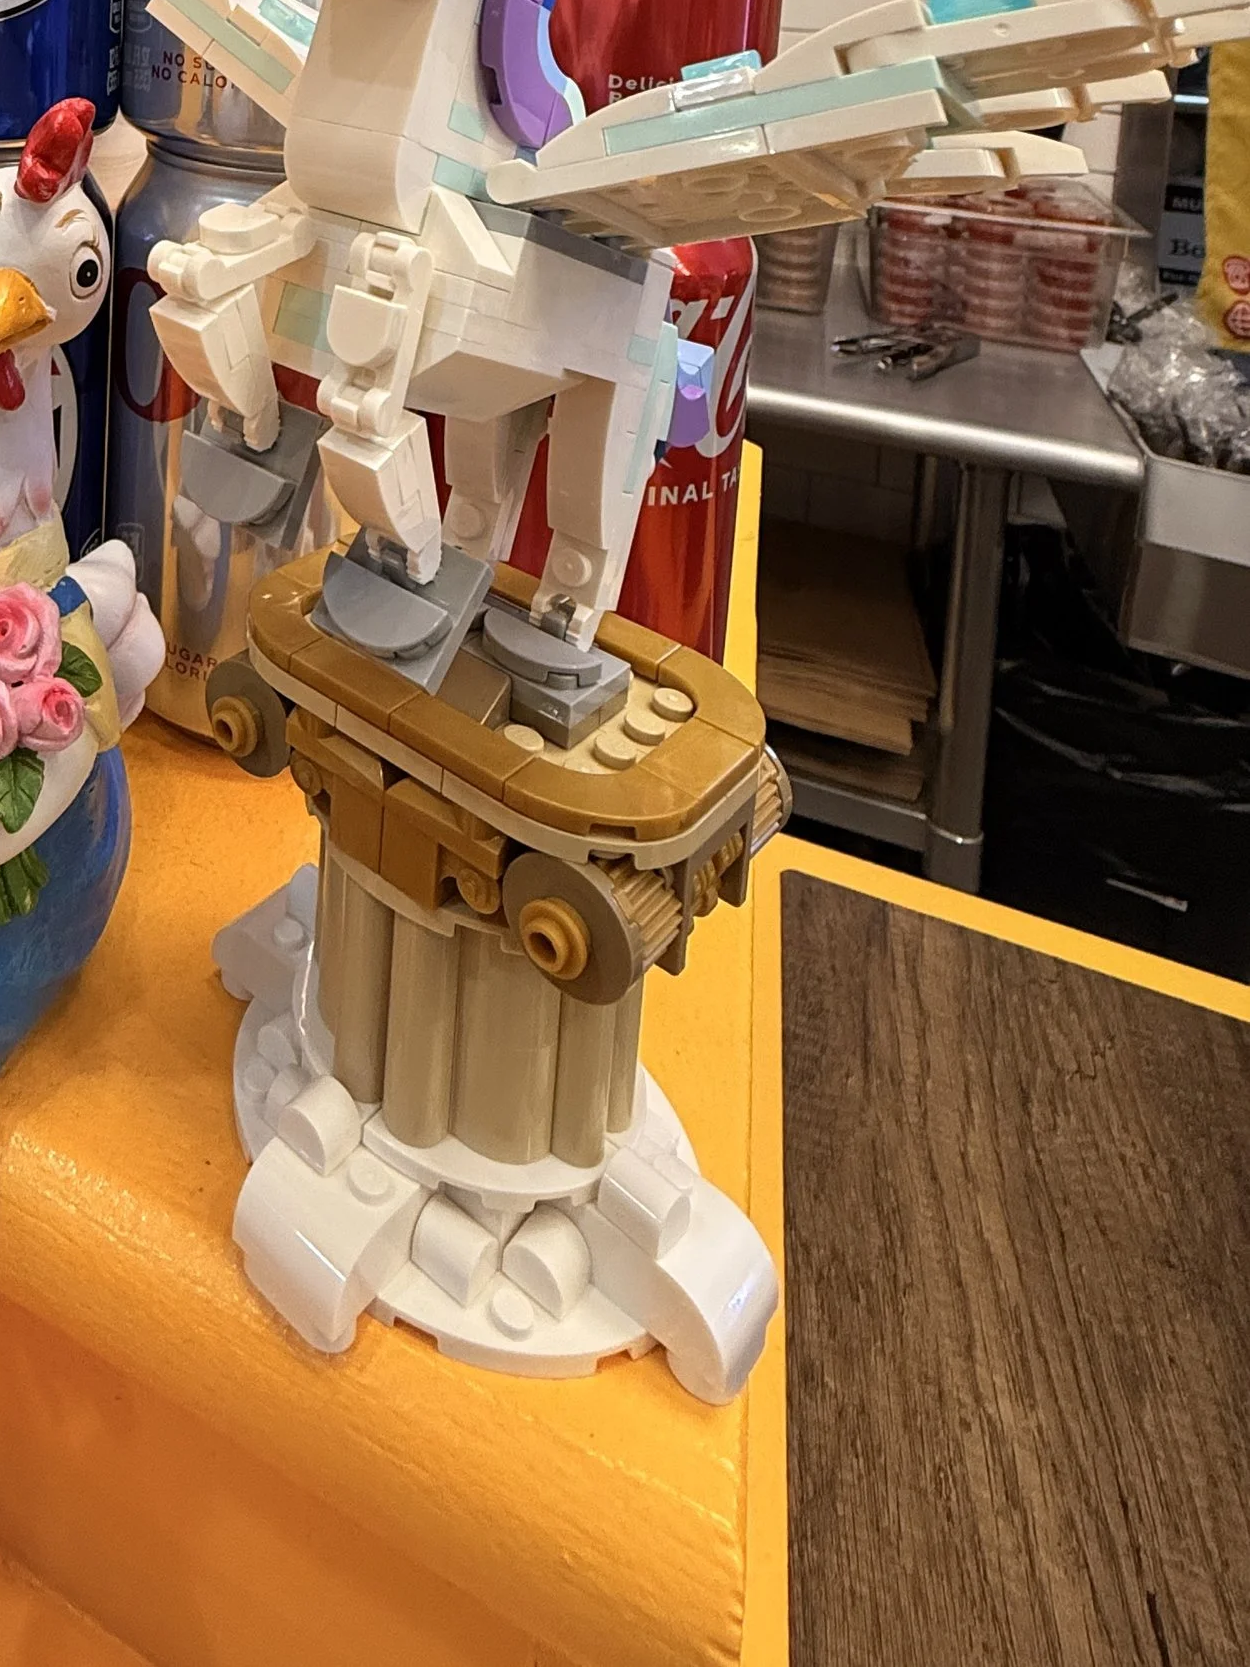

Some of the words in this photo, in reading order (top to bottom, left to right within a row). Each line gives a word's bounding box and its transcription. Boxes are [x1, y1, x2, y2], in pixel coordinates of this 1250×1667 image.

[163, 51, 185, 67] NO
[151, 64, 172, 81] NO
[177, 70, 234, 90] CALO
